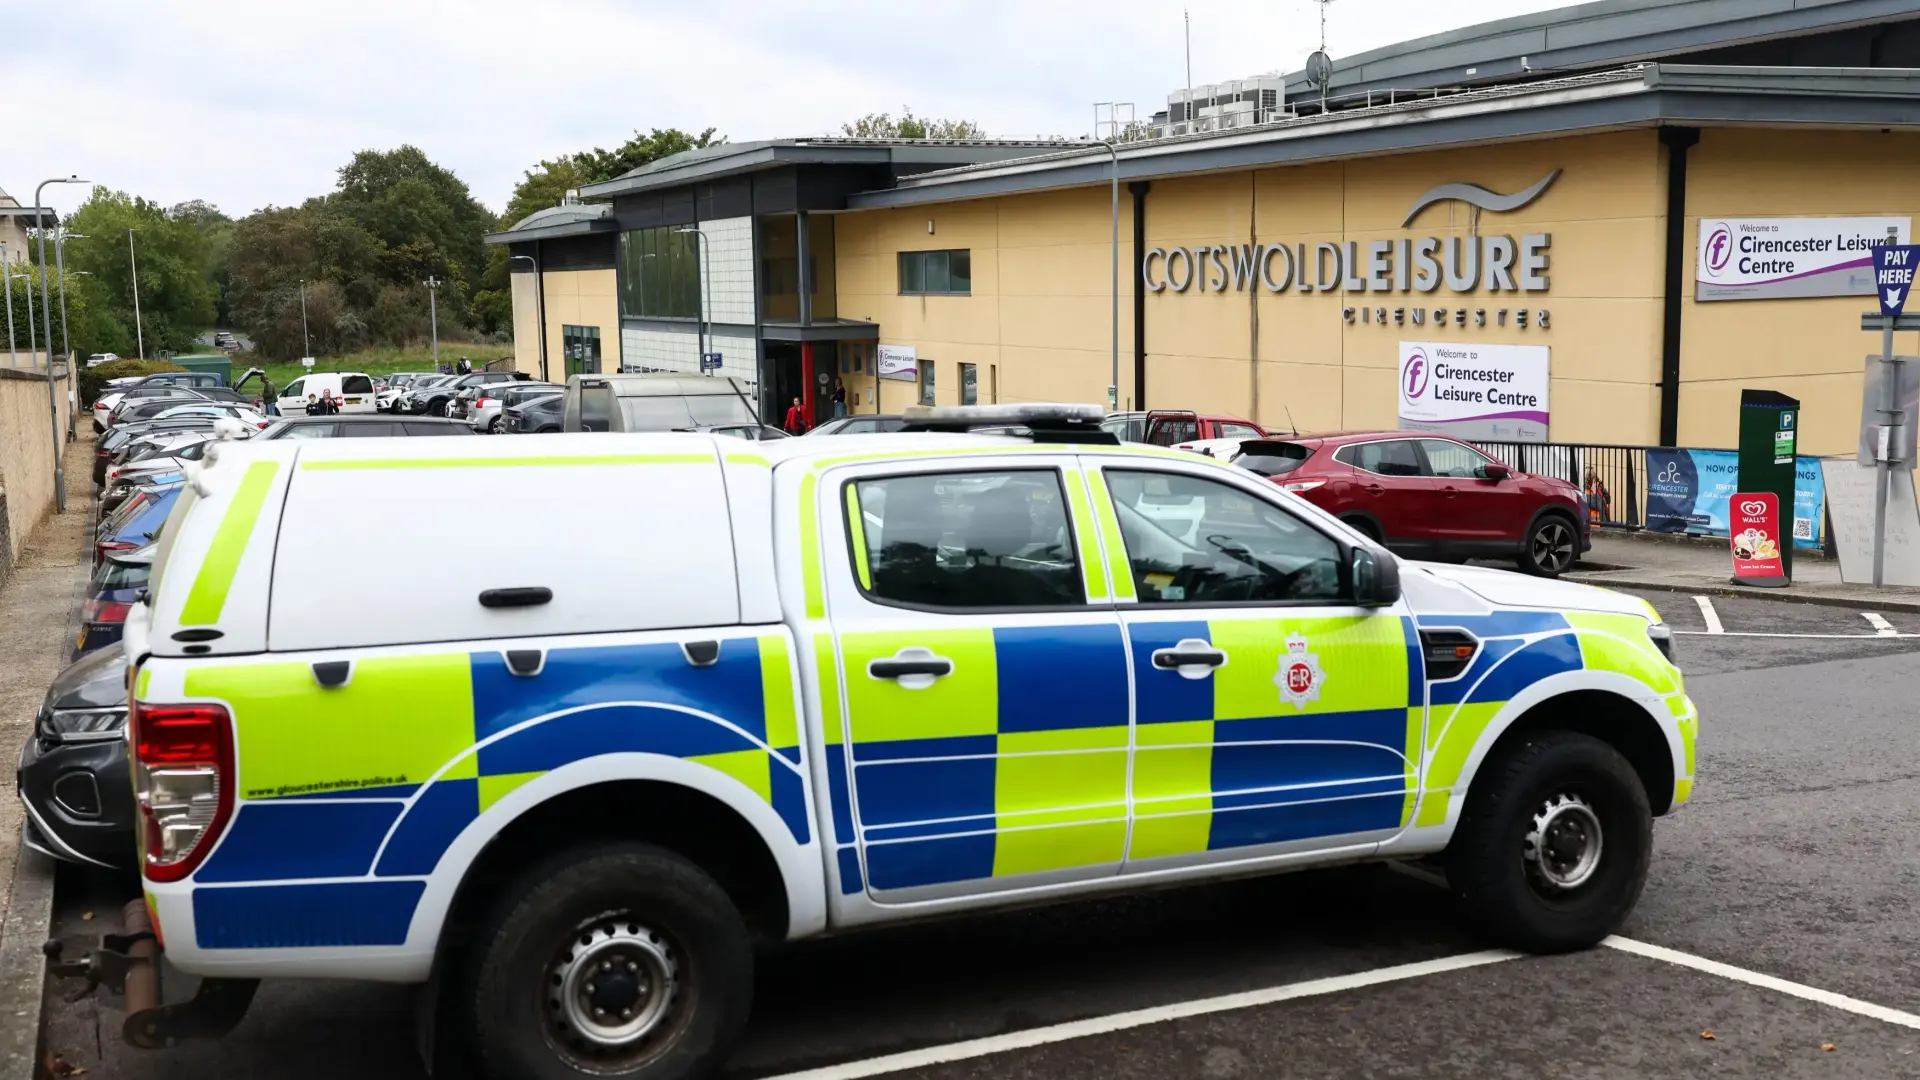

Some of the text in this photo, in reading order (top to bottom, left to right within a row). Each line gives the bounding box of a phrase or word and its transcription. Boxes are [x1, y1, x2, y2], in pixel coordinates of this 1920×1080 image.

[1739, 224, 1779, 233] Welcome to
[1739, 234, 1887, 253] Cirencester Leisur
[1739, 257, 1794, 274] Centre
[1884, 250, 1910, 265] PAY
[1878, 269, 1912, 284] HERE
[1342, 307, 1550, 328] CIRENCESTER
[1436, 348, 1478, 359] Welcome to
[1434, 364, 1514, 383] Cirencester
[1434, 384, 1537, 407] Leisure Centre
[1706, 464, 1726, 473] NOW
[1289, 668, 1310, 688] ER
[247, 774, 408, 795] www.gloucestershire.police.uk
